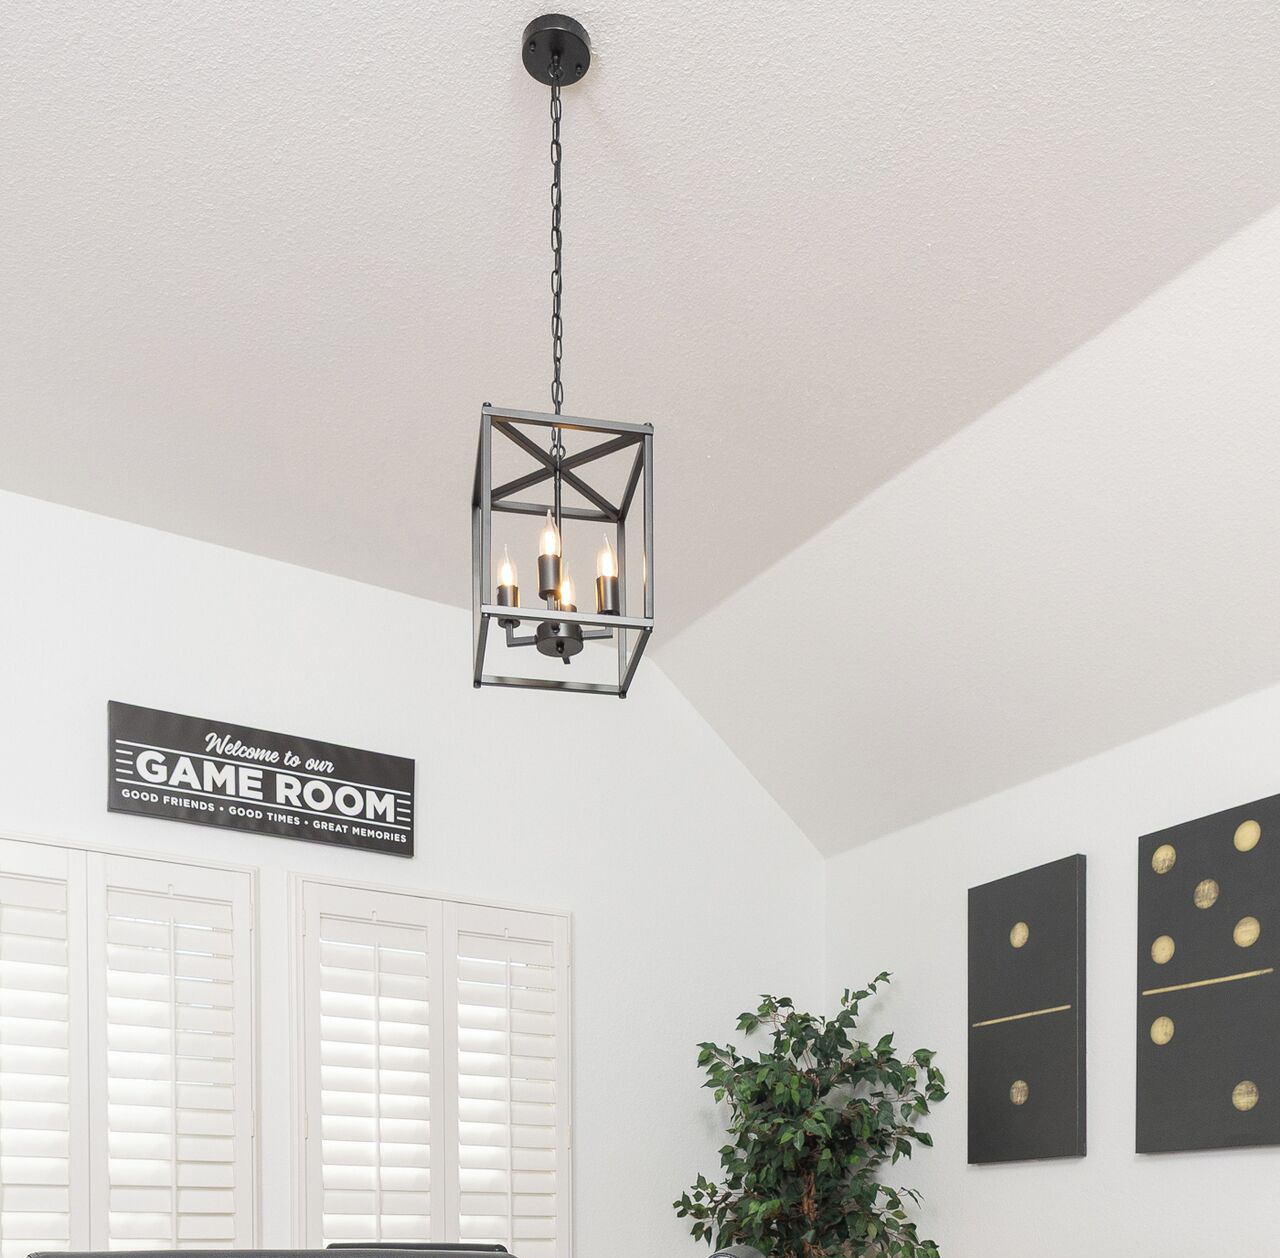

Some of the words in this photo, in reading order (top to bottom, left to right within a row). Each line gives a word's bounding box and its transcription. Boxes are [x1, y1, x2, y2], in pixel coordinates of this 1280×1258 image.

[205, 732, 280, 764] Welcome
[283, 750, 301, 767] to
[305, 758, 335, 773] our
[136, 750, 263, 800] GAME
[276, 773, 395, 823] ROOM
[121, 788, 159, 802] GOOD
[163, 795, 215, 812] FRIENDS
[229, 806, 263, 819] GOOD
[266, 812, 300, 825] TIMES
[312, 820, 349, 834] GREAT
[352, 826, 407, 843] MEMORIES
